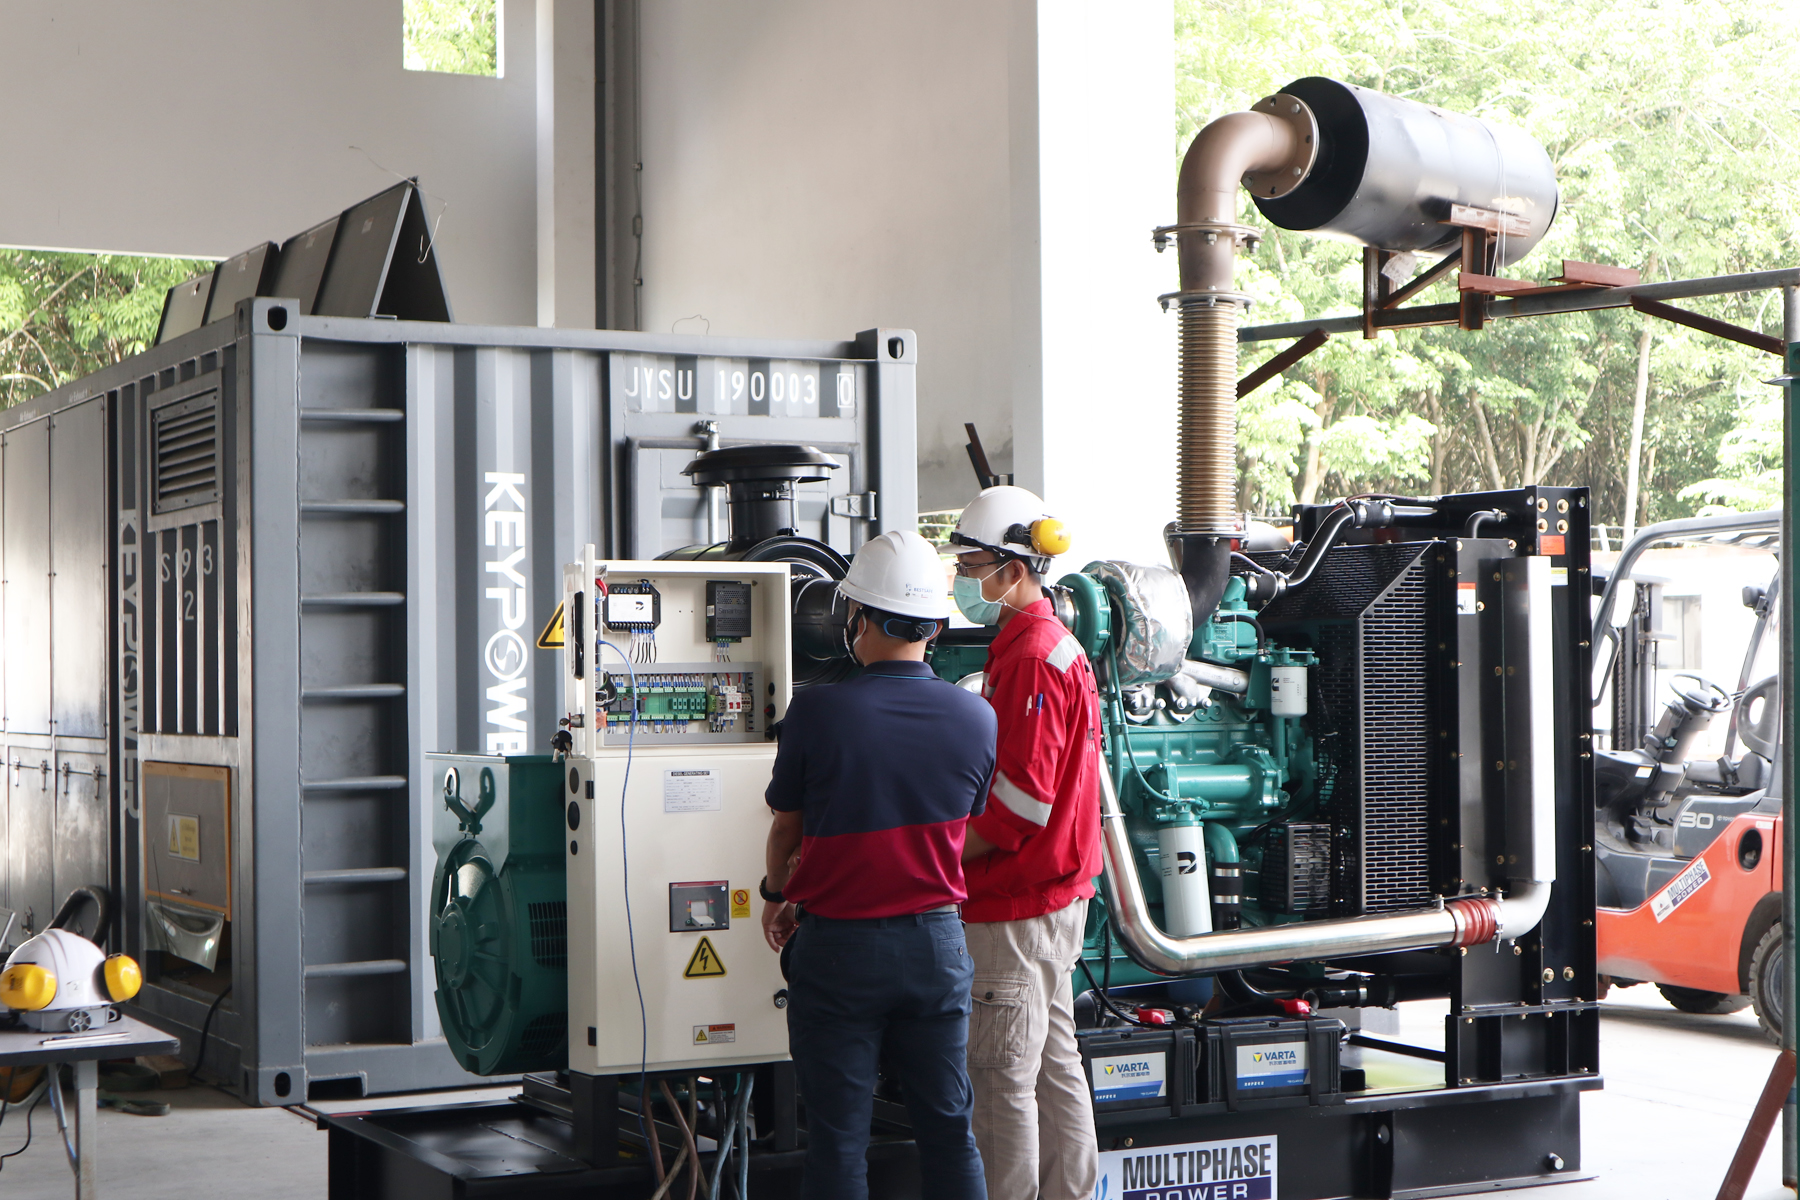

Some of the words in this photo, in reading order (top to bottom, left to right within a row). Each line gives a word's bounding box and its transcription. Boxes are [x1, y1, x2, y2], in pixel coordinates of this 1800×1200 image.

[625, 366, 693, 400] JYSU
[719, 370, 816, 404] 190003
[839, 374, 852, 406] 0
[484, 472, 527, 753] KEYPOWE
[1680, 812, 1714, 829] 30
[1667, 861, 1706, 900] MULTIPHASE
[1676, 876, 1704, 902] POWER
[1116, 1061, 1150, 1073] VARTA
[1264, 1050, 1296, 1061] VARTA
[1123, 1143, 1271, 1190] MULTIPHASE
